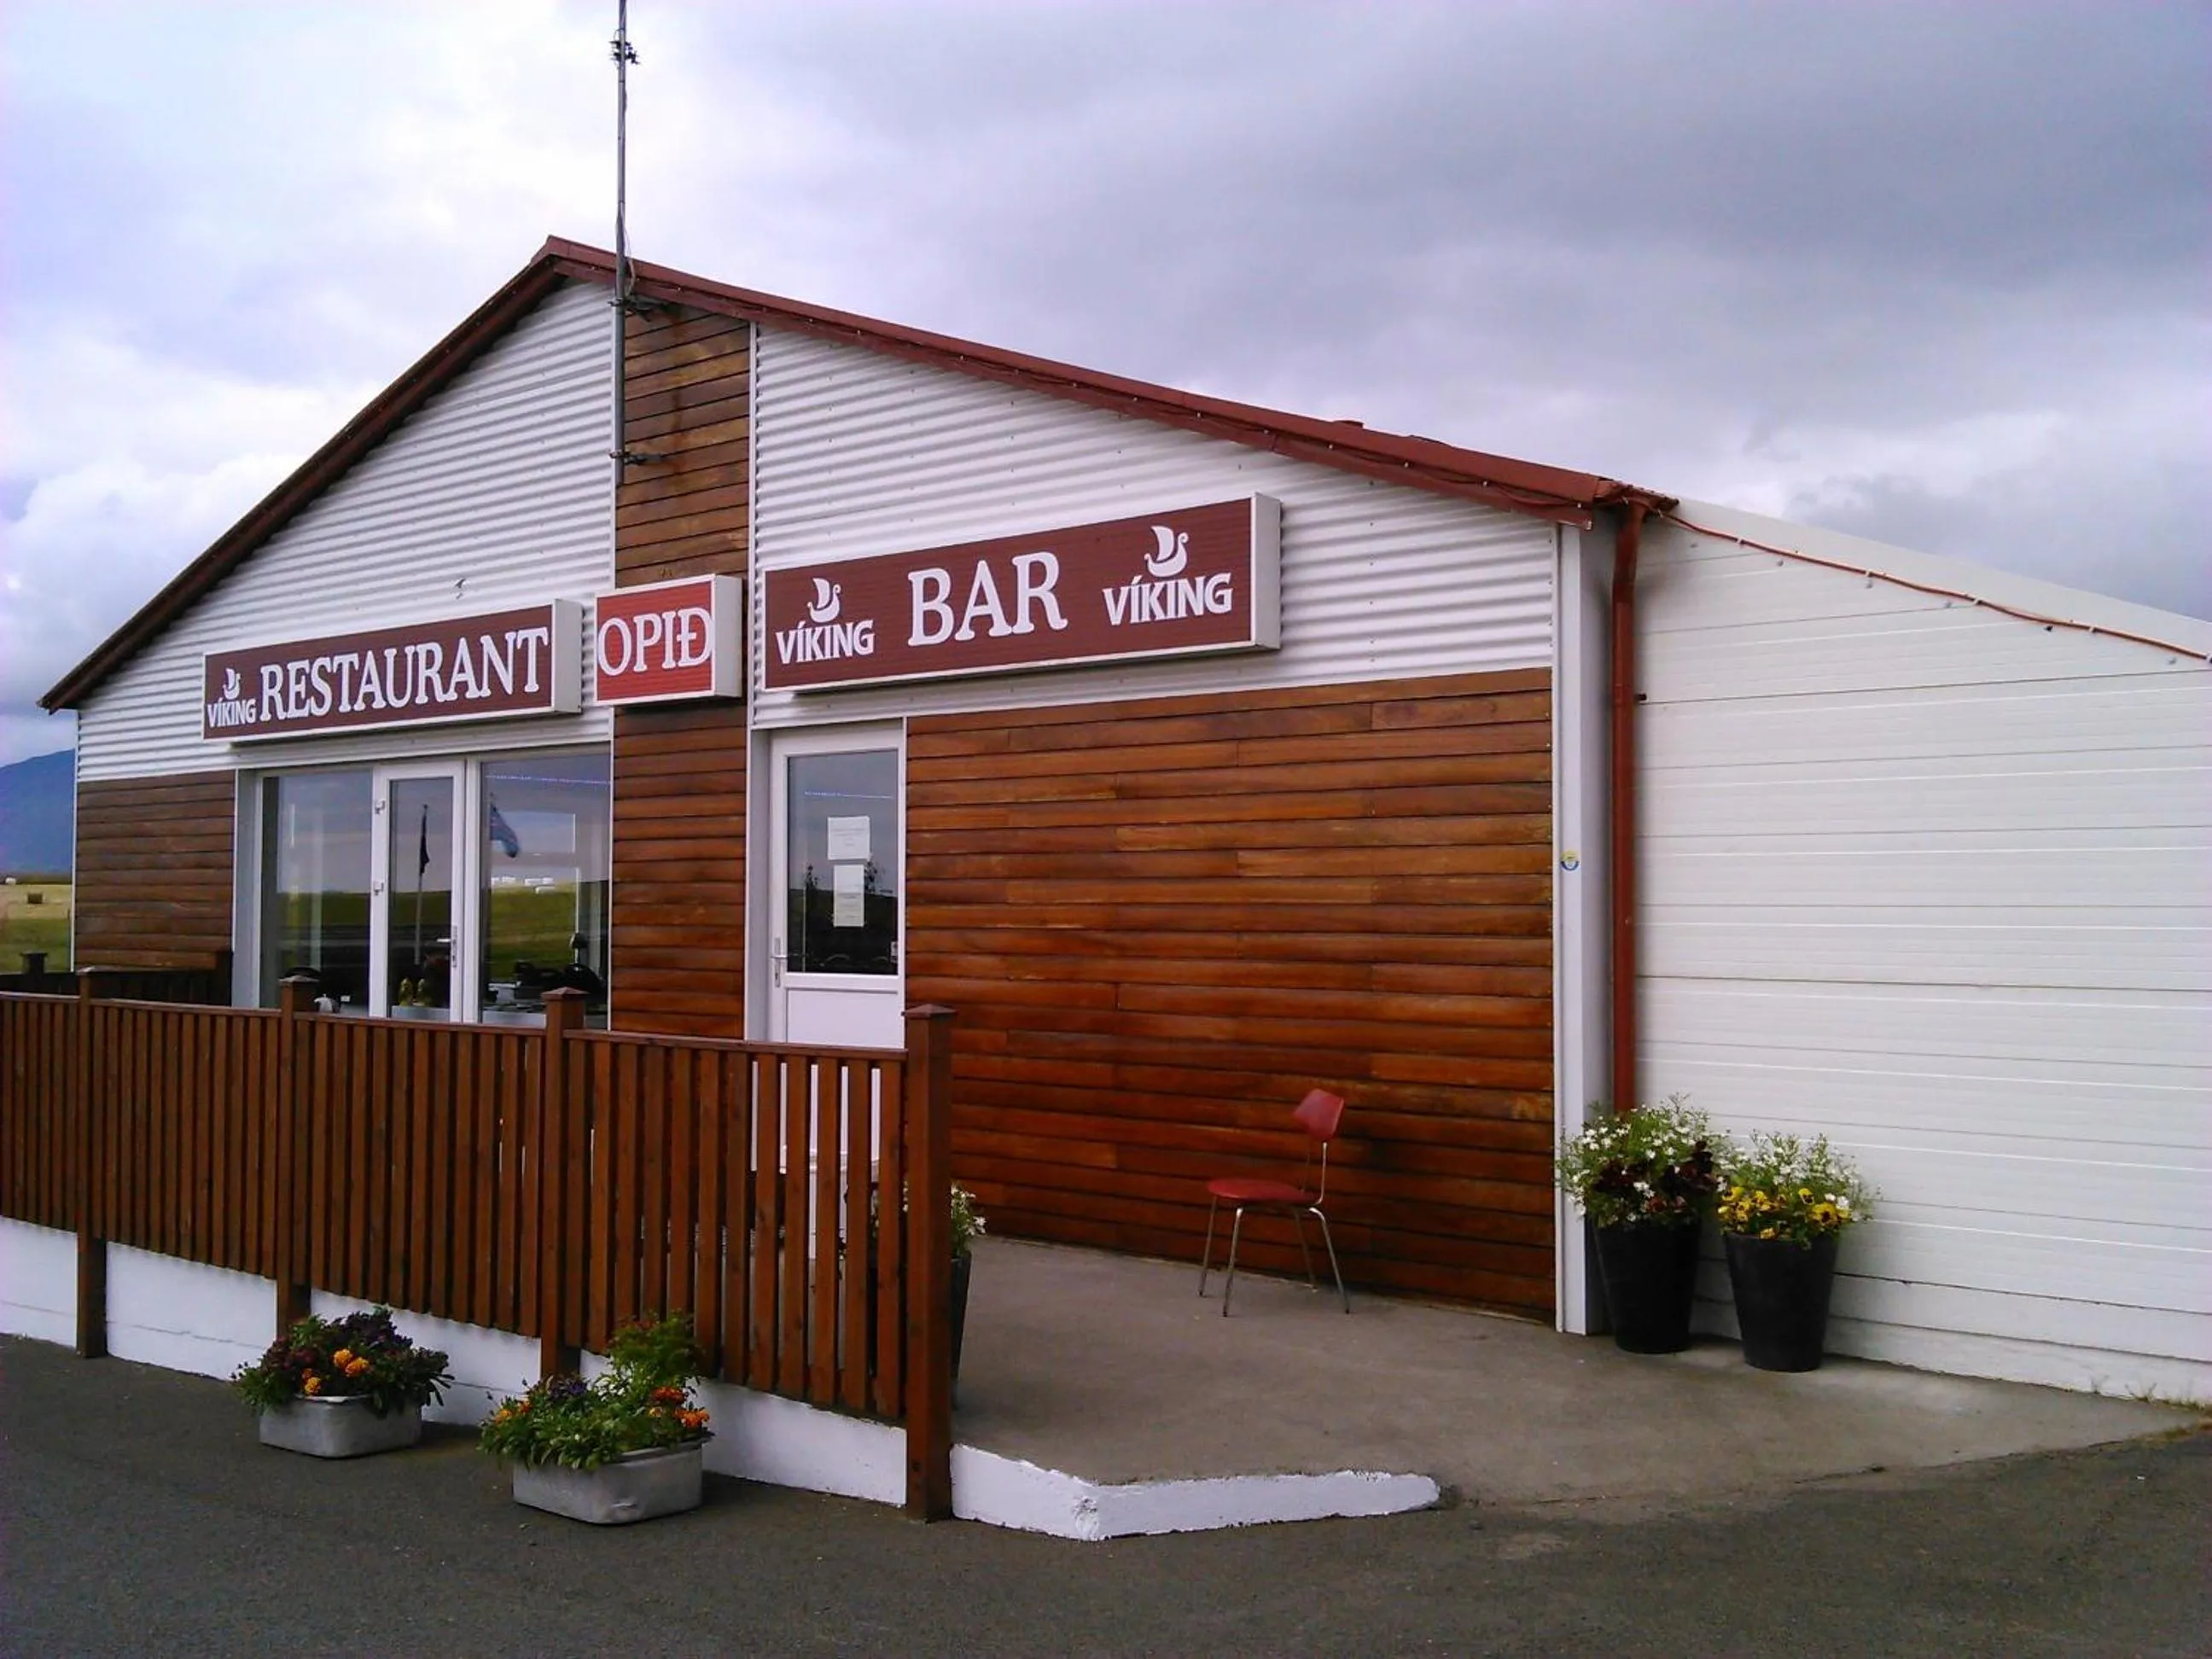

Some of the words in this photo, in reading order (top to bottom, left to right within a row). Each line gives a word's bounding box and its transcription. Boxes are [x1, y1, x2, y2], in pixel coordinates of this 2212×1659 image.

[907, 551, 1068, 647] BAR
[1103, 573, 1233, 626] VÍKING
[775, 620, 875, 665] VÍKING
[259, 627, 549, 721] RESTAURANT
[207, 697, 257, 727] VÍKING
